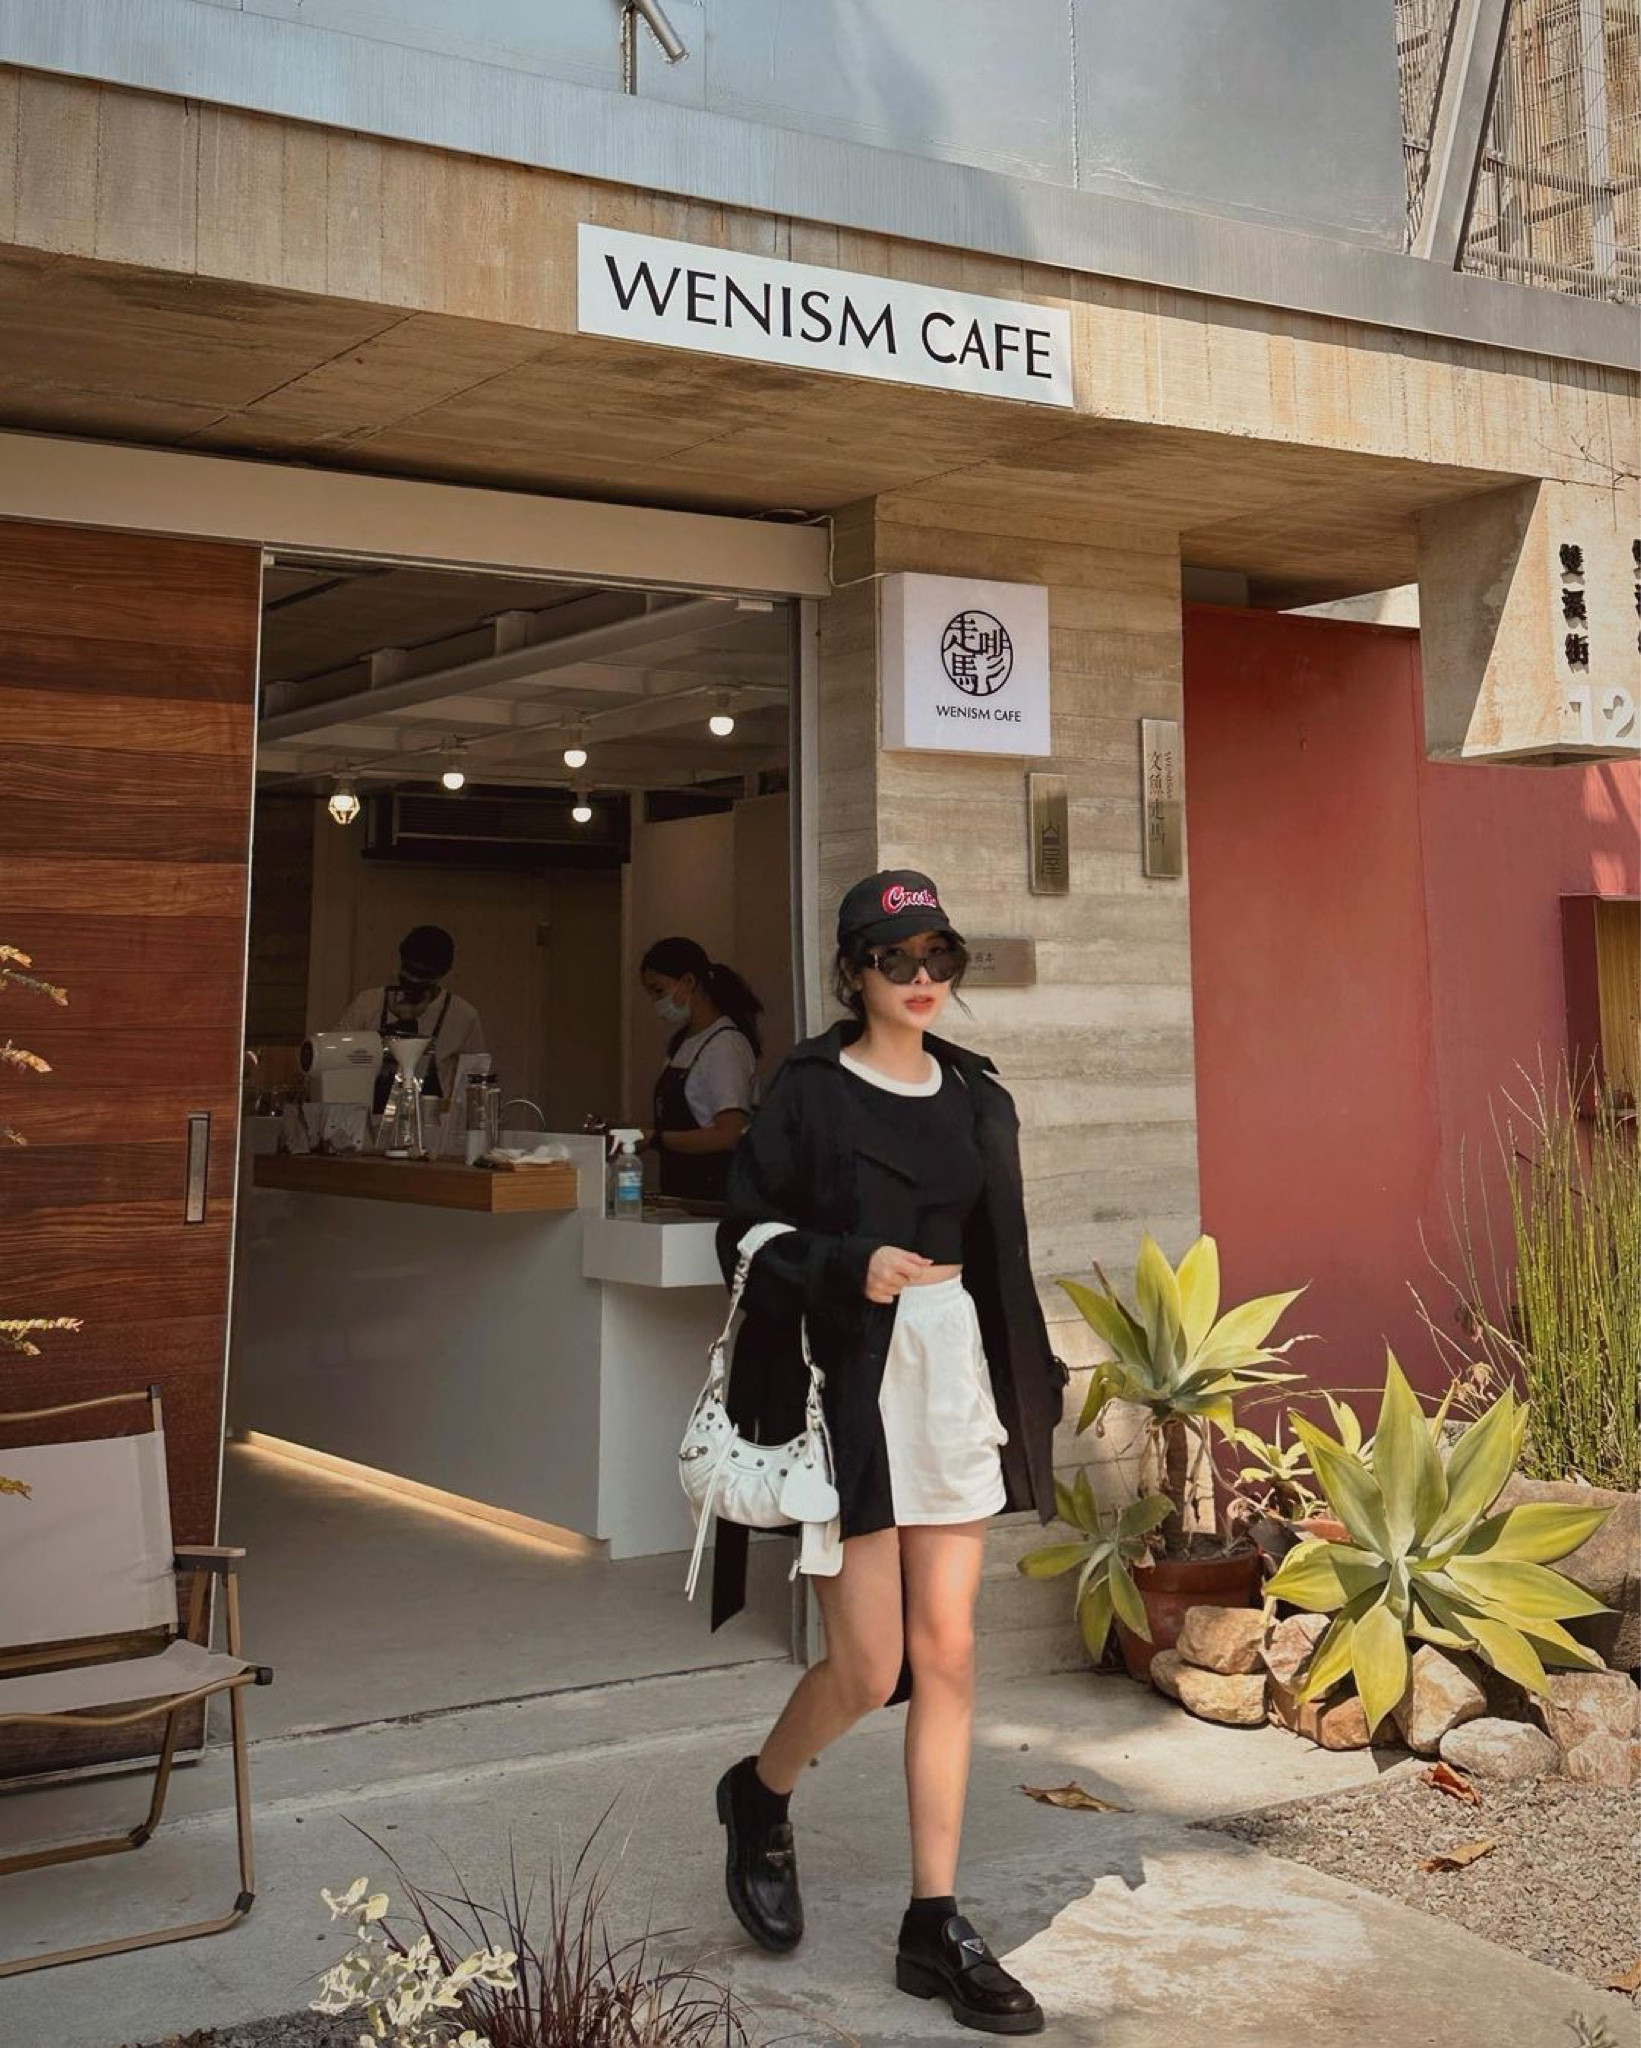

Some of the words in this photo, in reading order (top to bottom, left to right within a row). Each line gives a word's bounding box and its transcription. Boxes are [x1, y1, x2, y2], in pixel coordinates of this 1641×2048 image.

[604, 255, 897, 354] WENISM
[921, 312, 1053, 379] CAFE
[936, 704, 991, 720] WENISM
[994, 709, 1022, 722] CAFE
